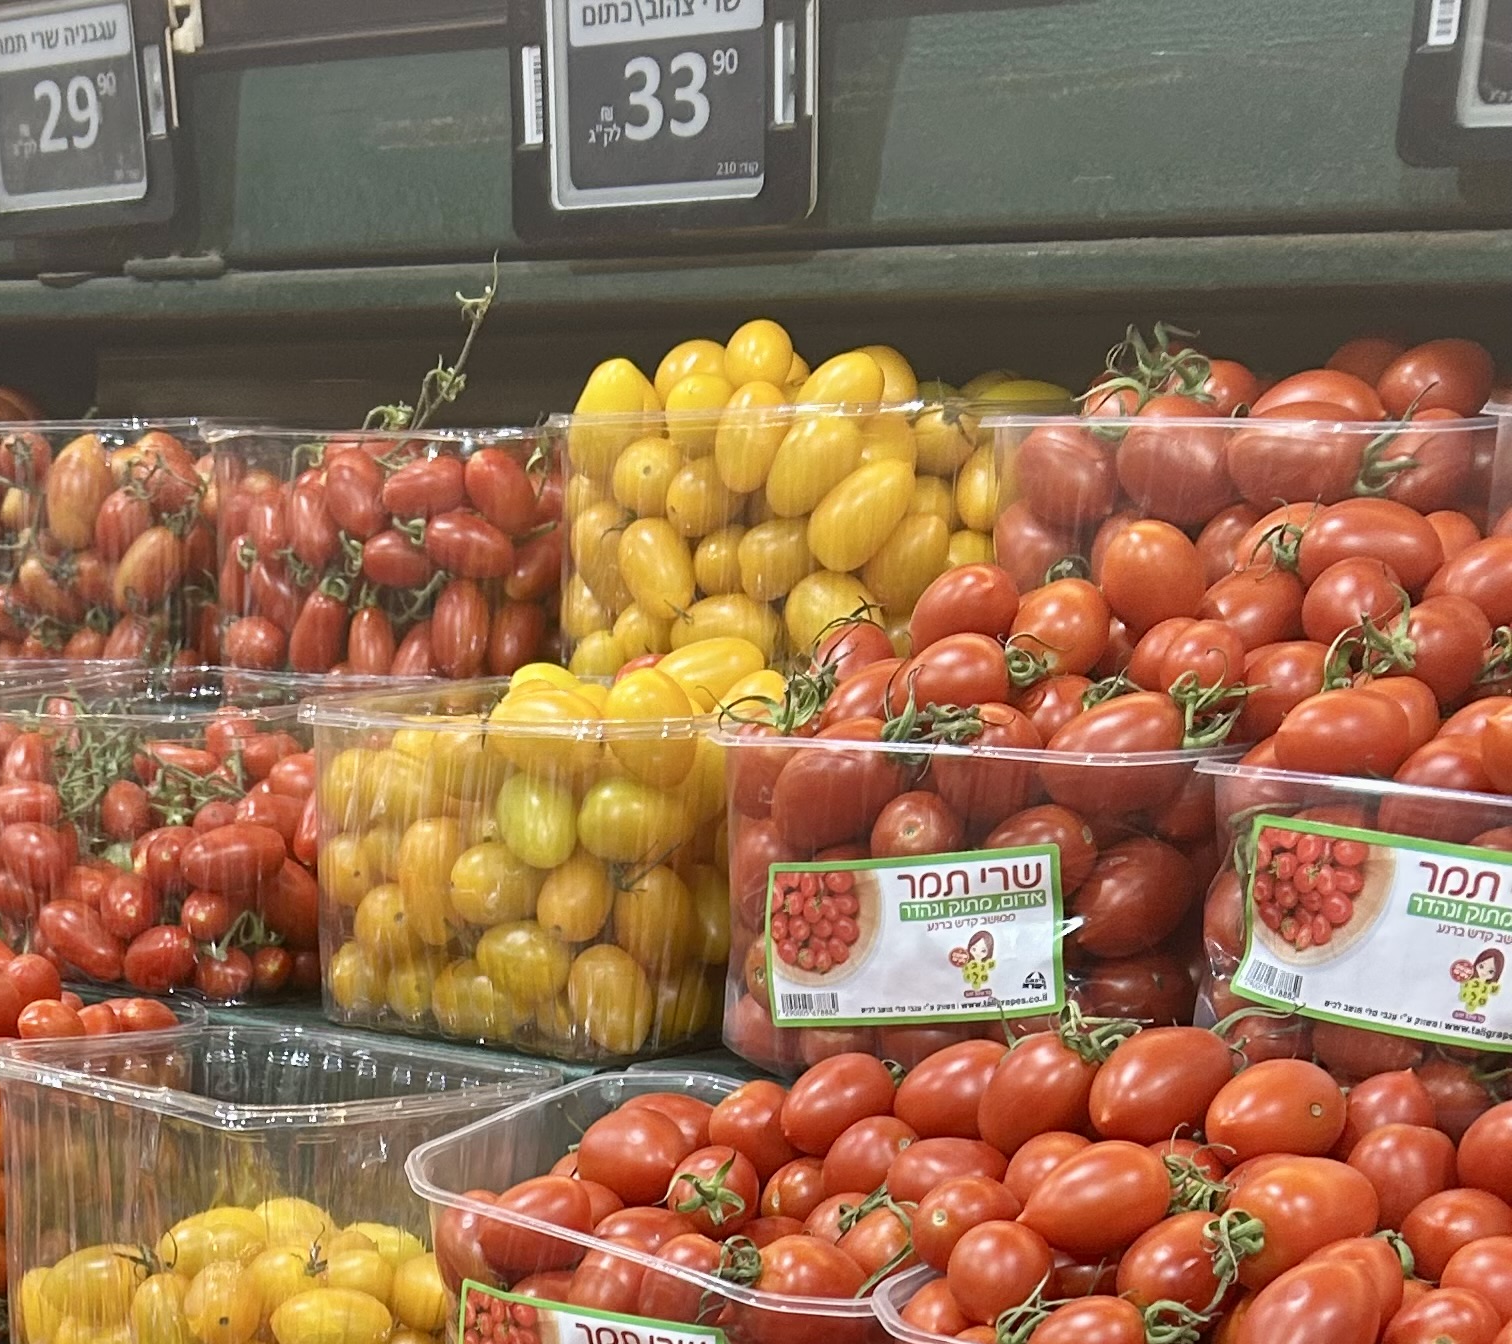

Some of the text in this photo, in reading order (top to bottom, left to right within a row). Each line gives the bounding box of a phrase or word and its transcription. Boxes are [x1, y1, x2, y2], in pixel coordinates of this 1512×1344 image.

[31, 29, 58, 50] שרי
[64, 20, 116, 46] עגבניה
[624, 48, 738, 140] 33 90
[34, 69, 117, 153] 29 90
[716, 162, 736, 175] 210
[897, 862, 1042, 899] שרי תמר
[1420, 861, 1500, 901] תמר
[902, 892, 1044, 919] אדום, מתוק ונהדר
[1413, 896, 1461, 916] ונהדר
